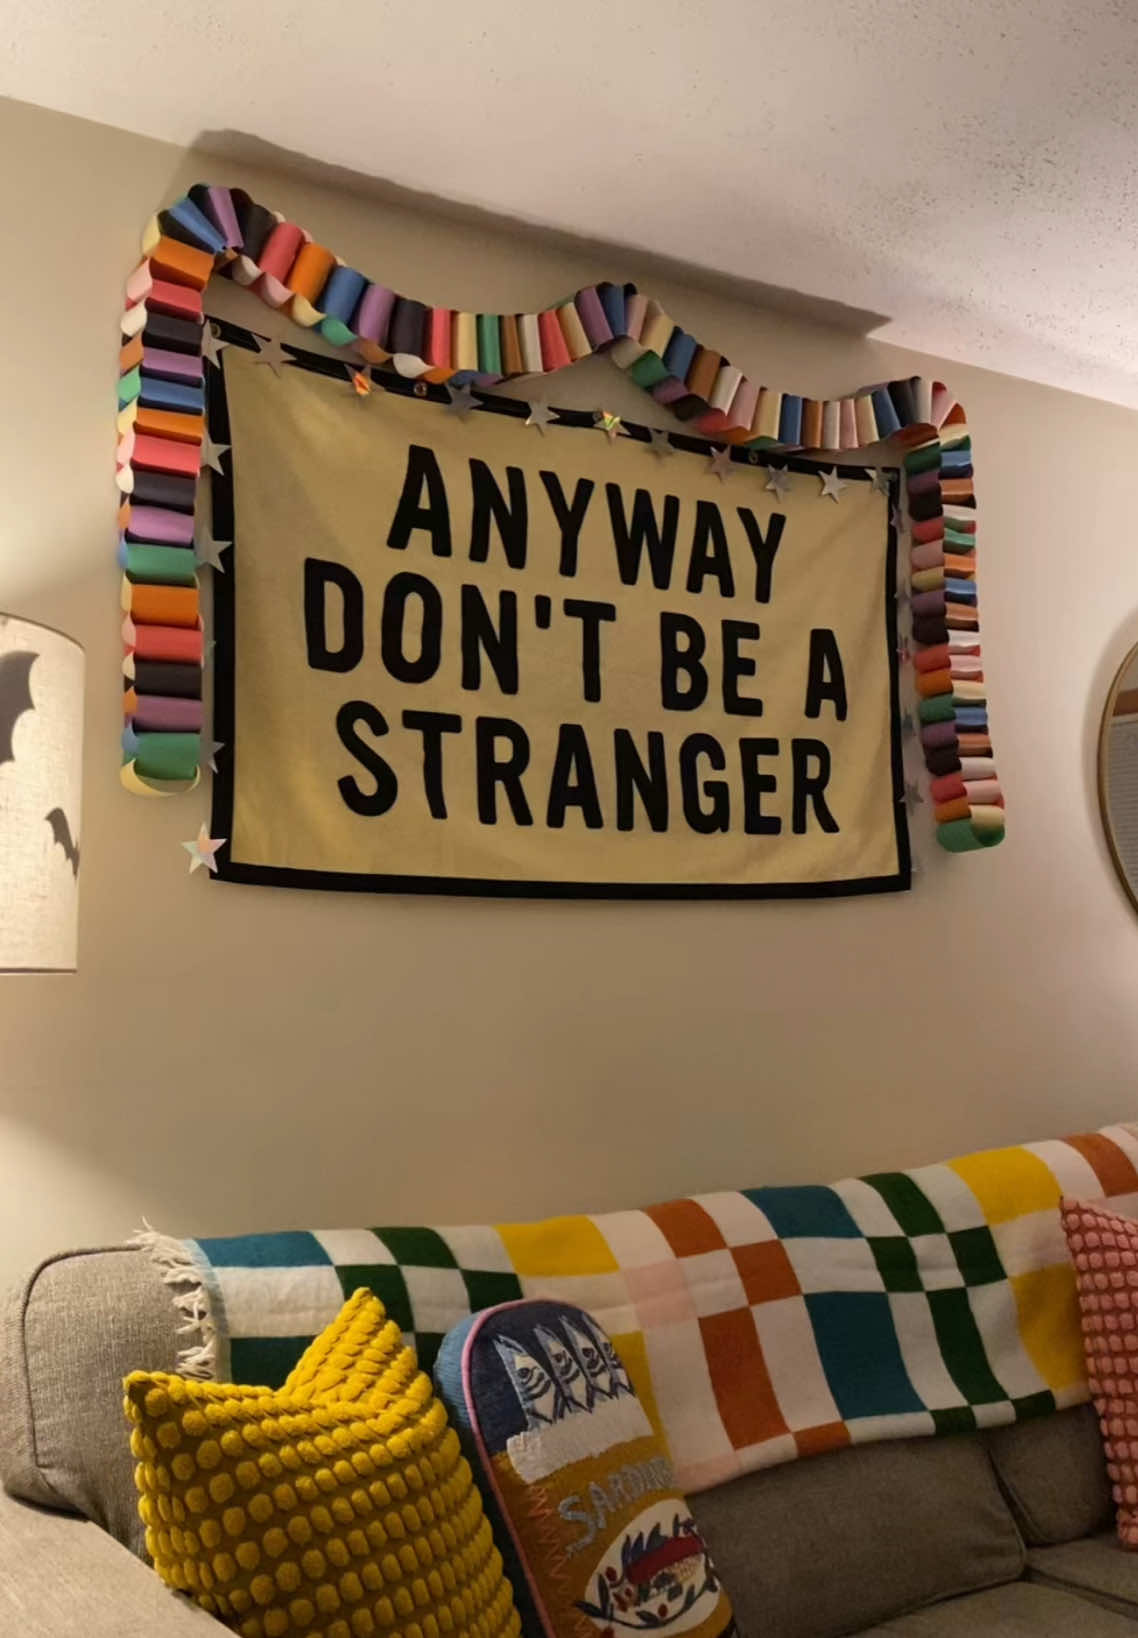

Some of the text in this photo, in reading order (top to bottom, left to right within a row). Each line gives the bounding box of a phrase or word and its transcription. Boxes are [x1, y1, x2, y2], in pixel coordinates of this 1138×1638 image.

[387, 445, 786, 603] ANYWAY
[304, 558, 847, 721] DON'T BE A
[336, 701, 839, 835] STRANGER
